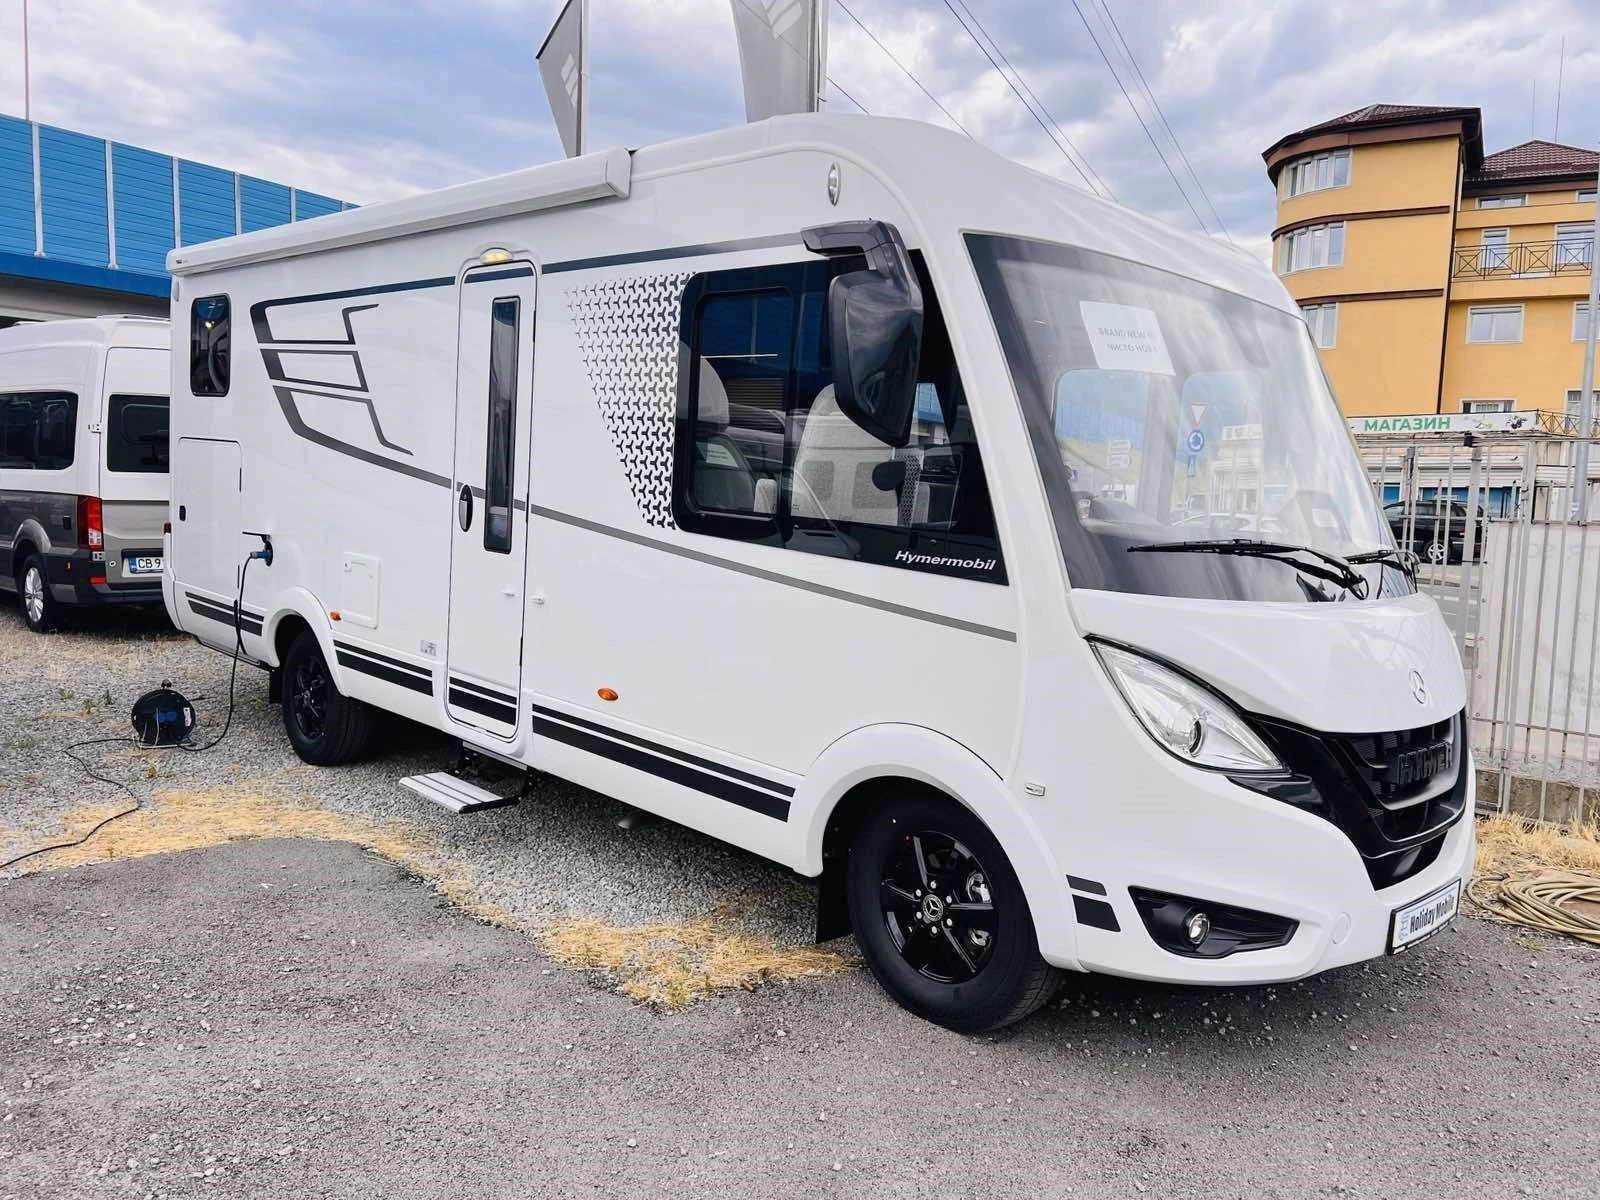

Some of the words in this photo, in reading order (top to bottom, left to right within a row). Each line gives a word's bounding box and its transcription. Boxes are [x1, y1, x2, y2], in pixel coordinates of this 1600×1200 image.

[1364, 417, 1451, 431] МАГАЗИН
[895, 550, 996, 570] Hymermobil
[1409, 908, 1436, 934] Holiday
[1435, 894, 1455, 920] Mobile
